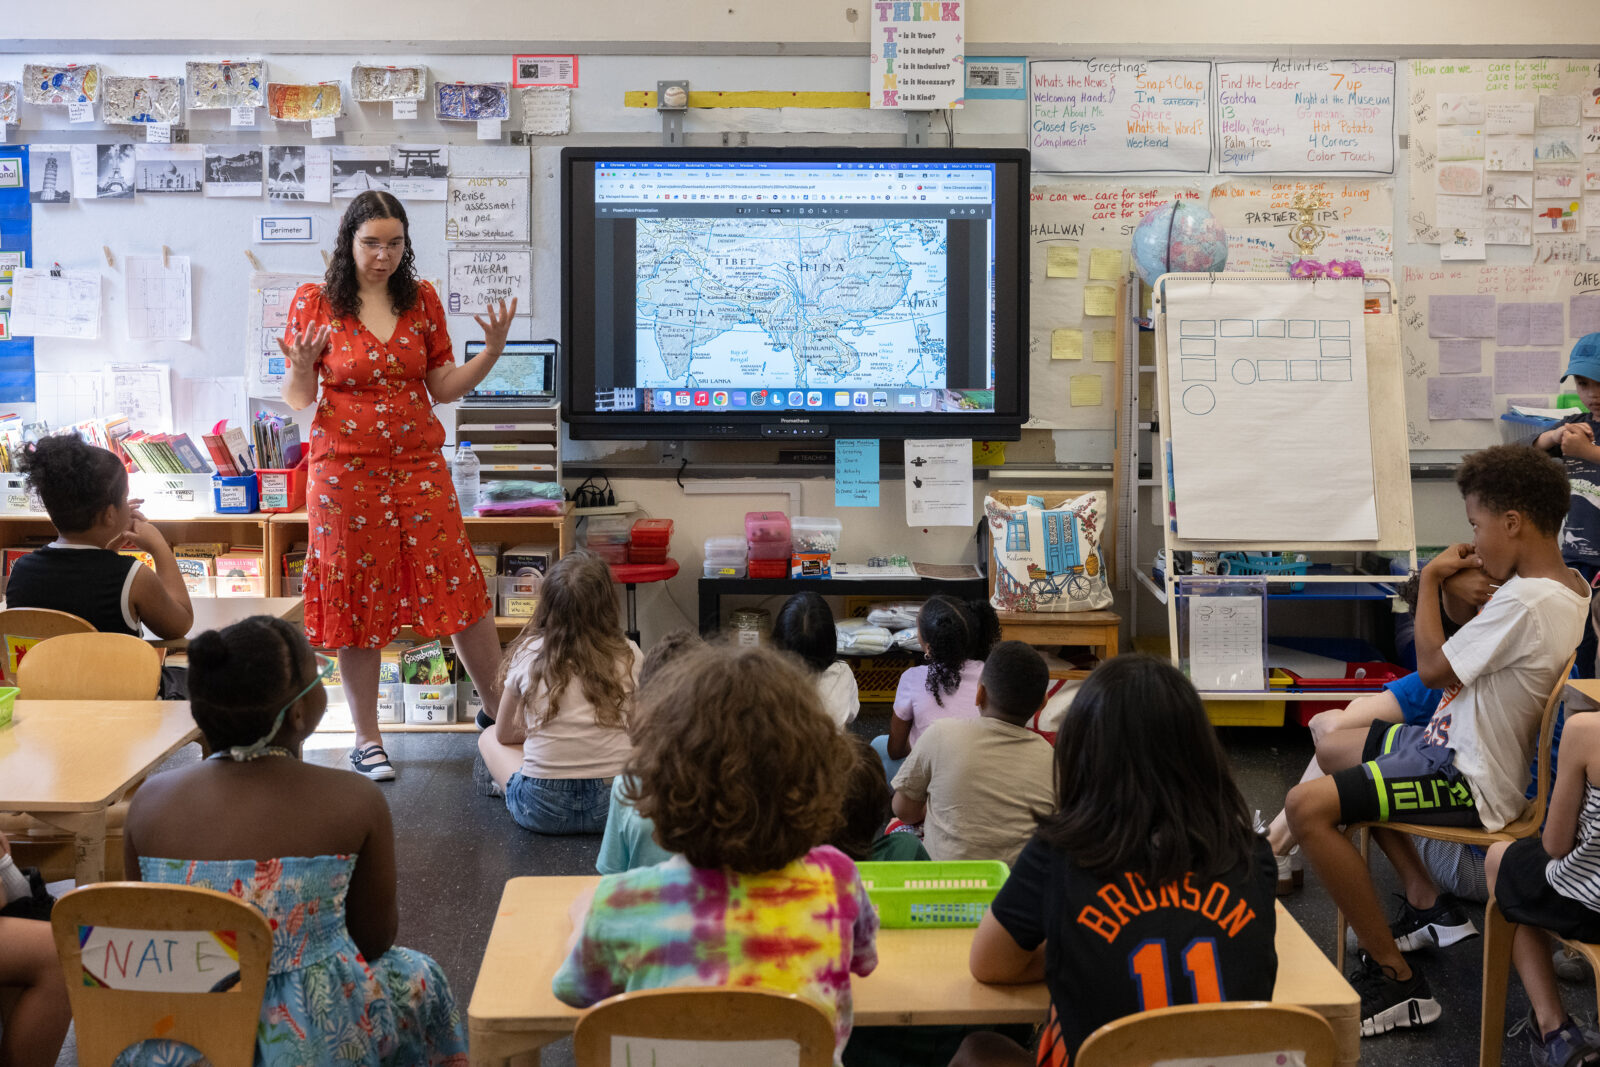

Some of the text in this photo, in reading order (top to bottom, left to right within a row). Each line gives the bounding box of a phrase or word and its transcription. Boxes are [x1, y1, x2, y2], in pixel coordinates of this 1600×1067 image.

[875, 2, 960, 22] THINK
[883, 27, 897, 42] T
[883, 43, 897, 58] H
[887, 59, 893, 73] I
[1087, 57, 1146, 77] Greetings
[1272, 58, 1328, 72] Activities
[1415, 61, 1436, 76] How
[1439, 64, 1454, 73] can
[1488, 63, 1511, 72] care
[1515, 61, 1526, 71] for
[1530, 61, 1549, 71] self
[1566, 62, 1590, 78] during
[883, 75, 897, 89] N
[1067, 75, 1081, 87] the
[1175, 74, 1203, 93] Clap
[1221, 74, 1300, 89] Find the Leader
[1328, 73, 1344, 90] 7
[1487, 72, 1559, 81] care for others
[1485, 82, 1509, 91] care
[1514, 81, 1528, 90] for
[883, 91, 898, 106] K
[1034, 92, 1076, 107] Welcoming
[1220, 91, 1256, 105] Gotcha
[1295, 92, 1317, 110] Night
[1333, 93, 1344, 104] the
[1348, 93, 1390, 105] Museum
[1035, 105, 1104, 118] Fact About Me
[1130, 104, 1172, 121] Sphere
[1222, 106, 1235, 119] 13
[1033, 120, 1096, 135] Closed Eyes
[1157, 119, 1203, 135] the Word?
[1313, 120, 1373, 133] Hot Potato
[1034, 134, 1087, 148] Compliment
[1126, 136, 1168, 148] Weekend
[1224, 135, 1245, 149] Palm
[1309, 134, 1358, 148] 4 Corners
[1222, 149, 1255, 165] Squirt
[1307, 149, 1375, 162] Color Touch
[454, 190, 485, 202] Revise
[1049, 189, 1200, 201] can care for self in the
[1211, 187, 1227, 199] How
[1231, 188, 1245, 196] can
[1272, 182, 1291, 190] care
[1309, 182, 1326, 190] self
[1341, 185, 1370, 201] during
[1271, 191, 1289, 199] care
[465, 198, 516, 211] assessment
[1094, 200, 1134, 210] care for
[1270, 200, 1289, 208] care
[1092, 211, 1116, 220] care
[1121, 210, 1133, 218] for
[1245, 210, 1339, 224] PARTNERIPS
[271, 227, 302, 235] perimeter
[1030, 223, 1085, 236] HALLWAY
[473, 253, 492, 262] MAY
[464, 264, 508, 275] TANGRAM
[786, 262, 845, 272] CHINA
[473, 275, 521, 287] ACTIVITY
[1405, 268, 1423, 282] How
[902, 300, 938, 308] TAIWAN
[677, 396, 688, 404] 15
[404, 648, 440, 667] Goosebumps
[427, 711, 432, 720] S
[103, 938, 215, 978] NATE
[1128, 937, 1226, 1011] 11
